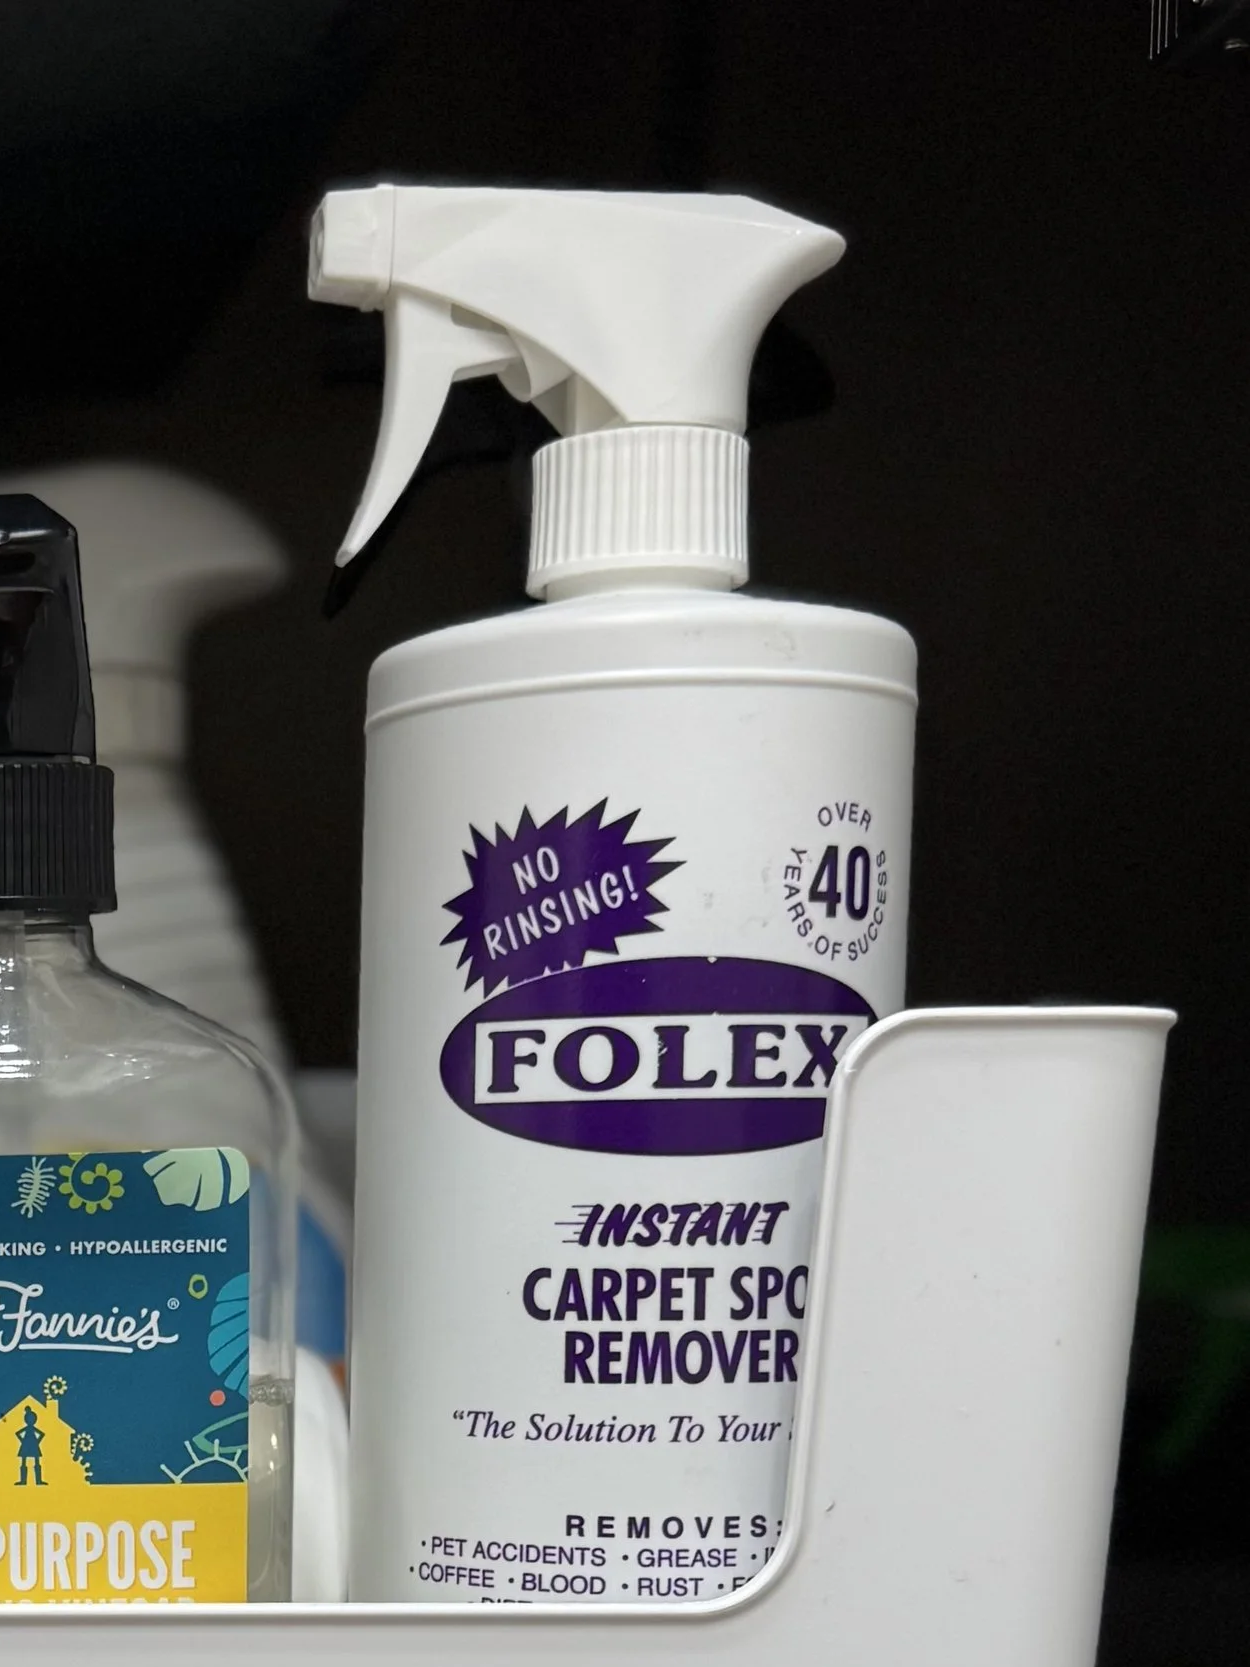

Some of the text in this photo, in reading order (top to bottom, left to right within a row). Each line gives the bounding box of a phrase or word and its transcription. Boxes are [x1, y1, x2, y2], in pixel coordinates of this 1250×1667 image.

[818, 802, 872, 832] OVER
[512, 846, 559, 895] NO
[808, 845, 871, 921] 40
[483, 871, 640, 960] RINSING!
[784, 847, 888, 961] YEARS OF SUCCESS
[487, 1024, 848, 1093] FOLEX
[70, 1238, 227, 1256] HYPOALLERGENIC
[576, 1201, 790, 1247] INSTANT
[521, 1264, 809, 1322] CARPET SPO
[564, 1330, 799, 1385] REMOVER
[525, 1412, 657, 1443] Solution
[668, 1415, 705, 1443] To
[717, 1414, 782, 1443] Your
[565, 1514, 782, 1539] REMOVES:
[431, 1536, 737, 1568] PET ACCIDENTS GREASE
[419, 1562, 704, 1597] COFFEE BLOOD RUST
